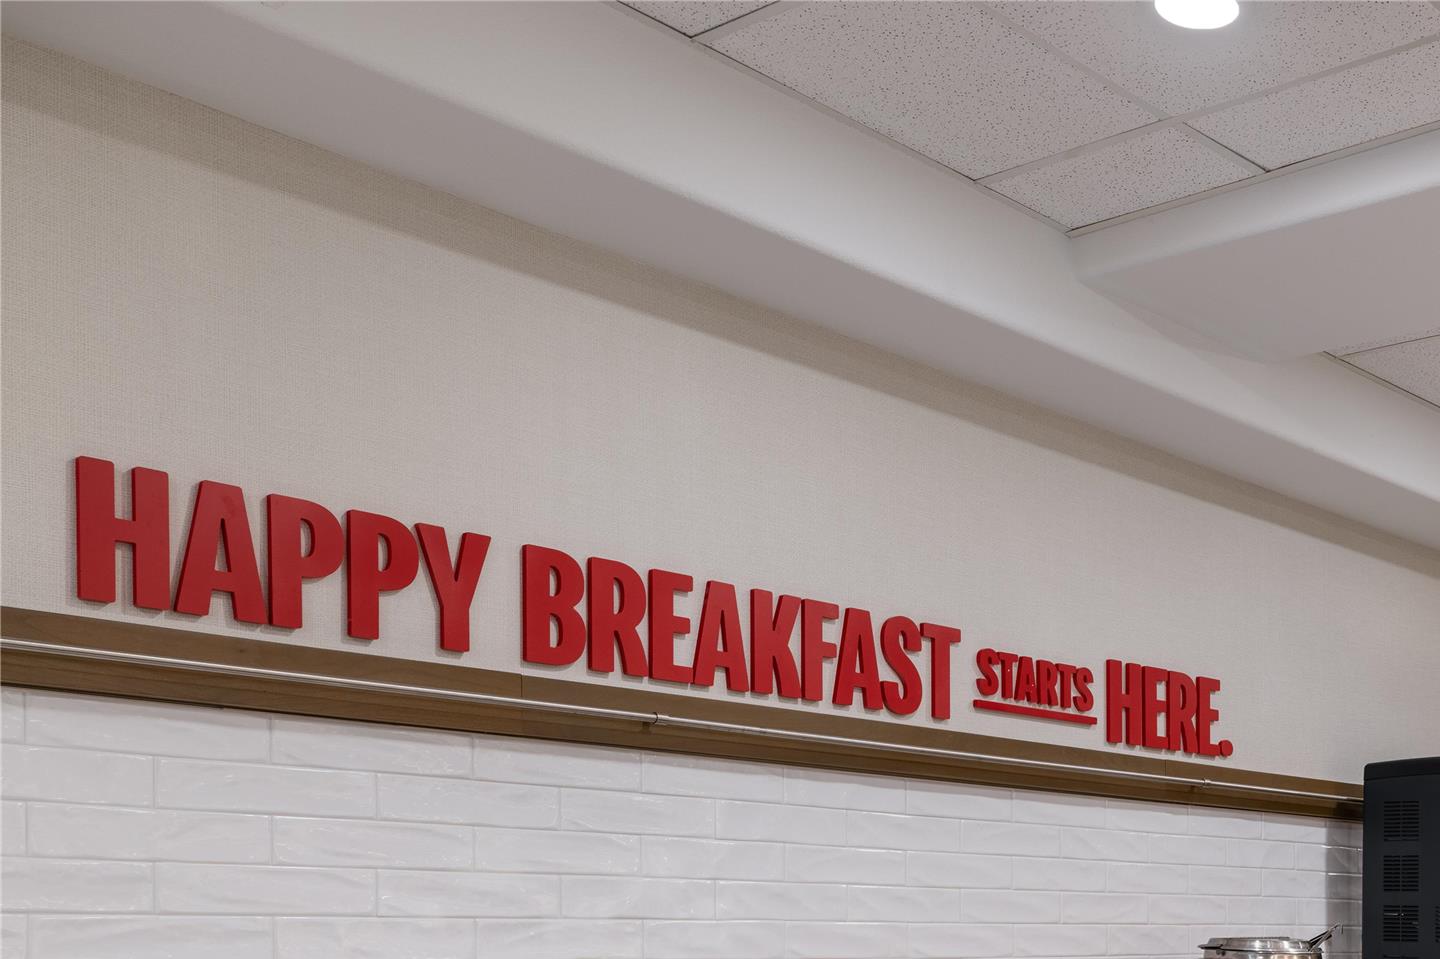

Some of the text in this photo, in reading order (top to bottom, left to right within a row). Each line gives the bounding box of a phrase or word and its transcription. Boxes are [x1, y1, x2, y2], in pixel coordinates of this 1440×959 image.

[75, 456, 1234, 758] HAPPY BREAKFAST STARTS HERE.
